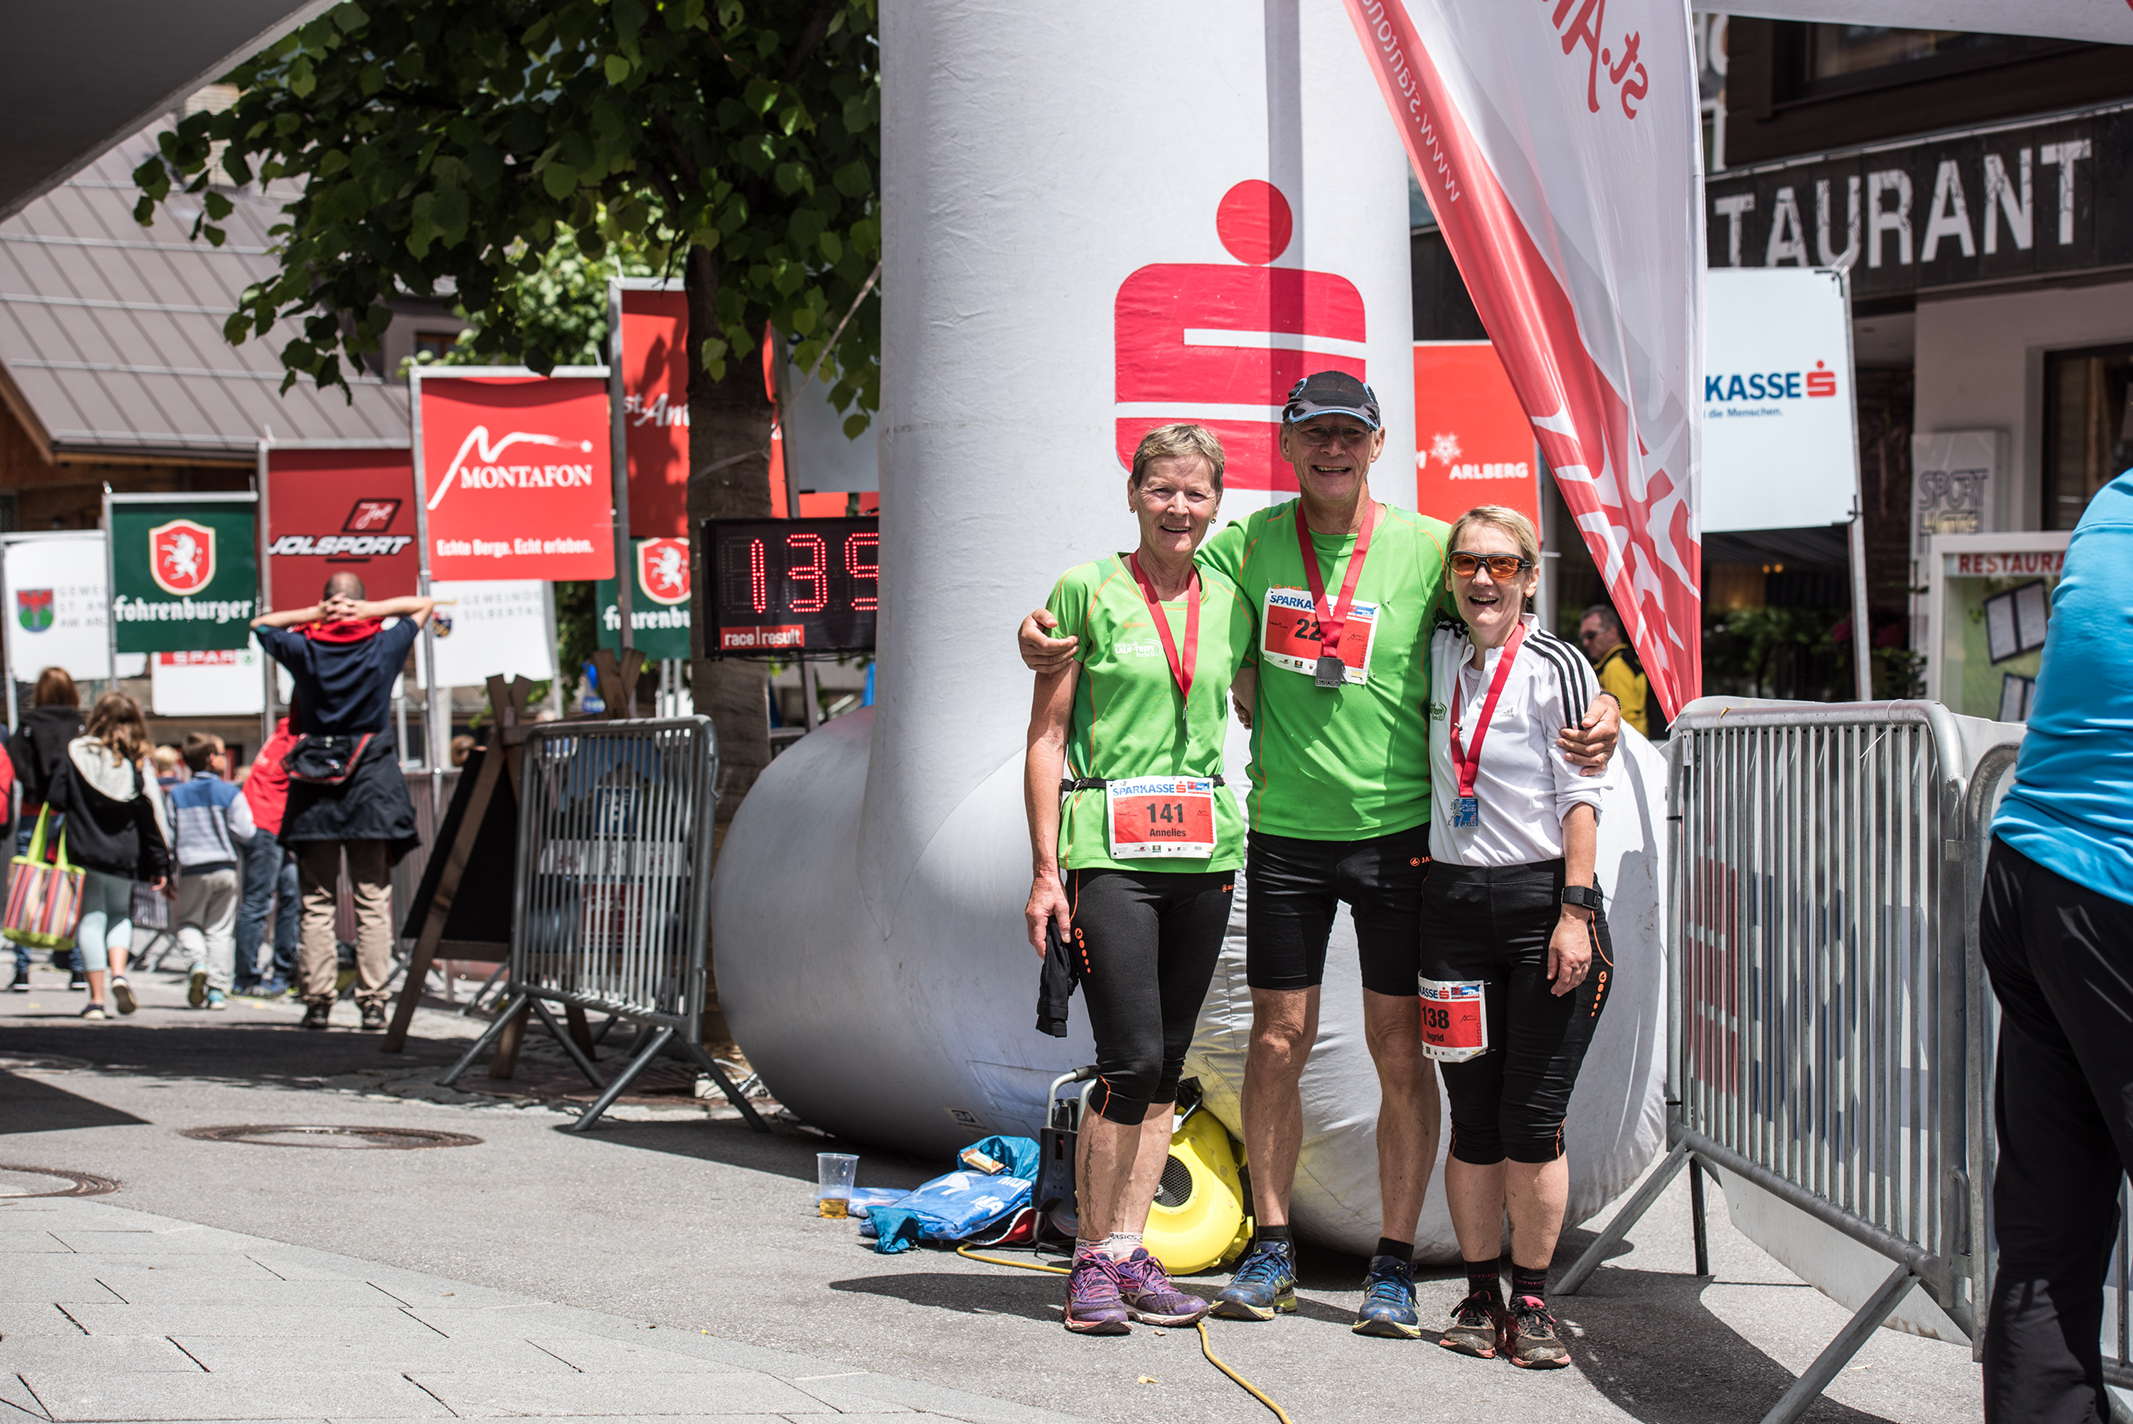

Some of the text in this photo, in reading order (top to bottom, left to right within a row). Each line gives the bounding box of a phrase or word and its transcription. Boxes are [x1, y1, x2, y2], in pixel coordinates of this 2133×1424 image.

[1715, 139, 2092, 269] TAURANT
[1704, 372, 1802, 402] KASSE
[460, 465, 592, 488] MONTAFON
[1449, 462, 1528, 480] ARLBERG
[1917, 468, 1989, 511] SPORT
[267, 535, 413, 555] JOLSPORT
[436, 537, 594, 558] Echte Berge. Echt erleben.
[113, 595, 253, 624] fohrenburger
[173, 652, 235, 665] SPAR
[1112, 784, 1175, 796] SPARKASSE
[1146, 803, 1184, 823] 141
[1149, 828, 1187, 838] Annelies
[1422, 1005, 1450, 1029] 138
[1427, 1030, 1444, 1042] Ingrid
